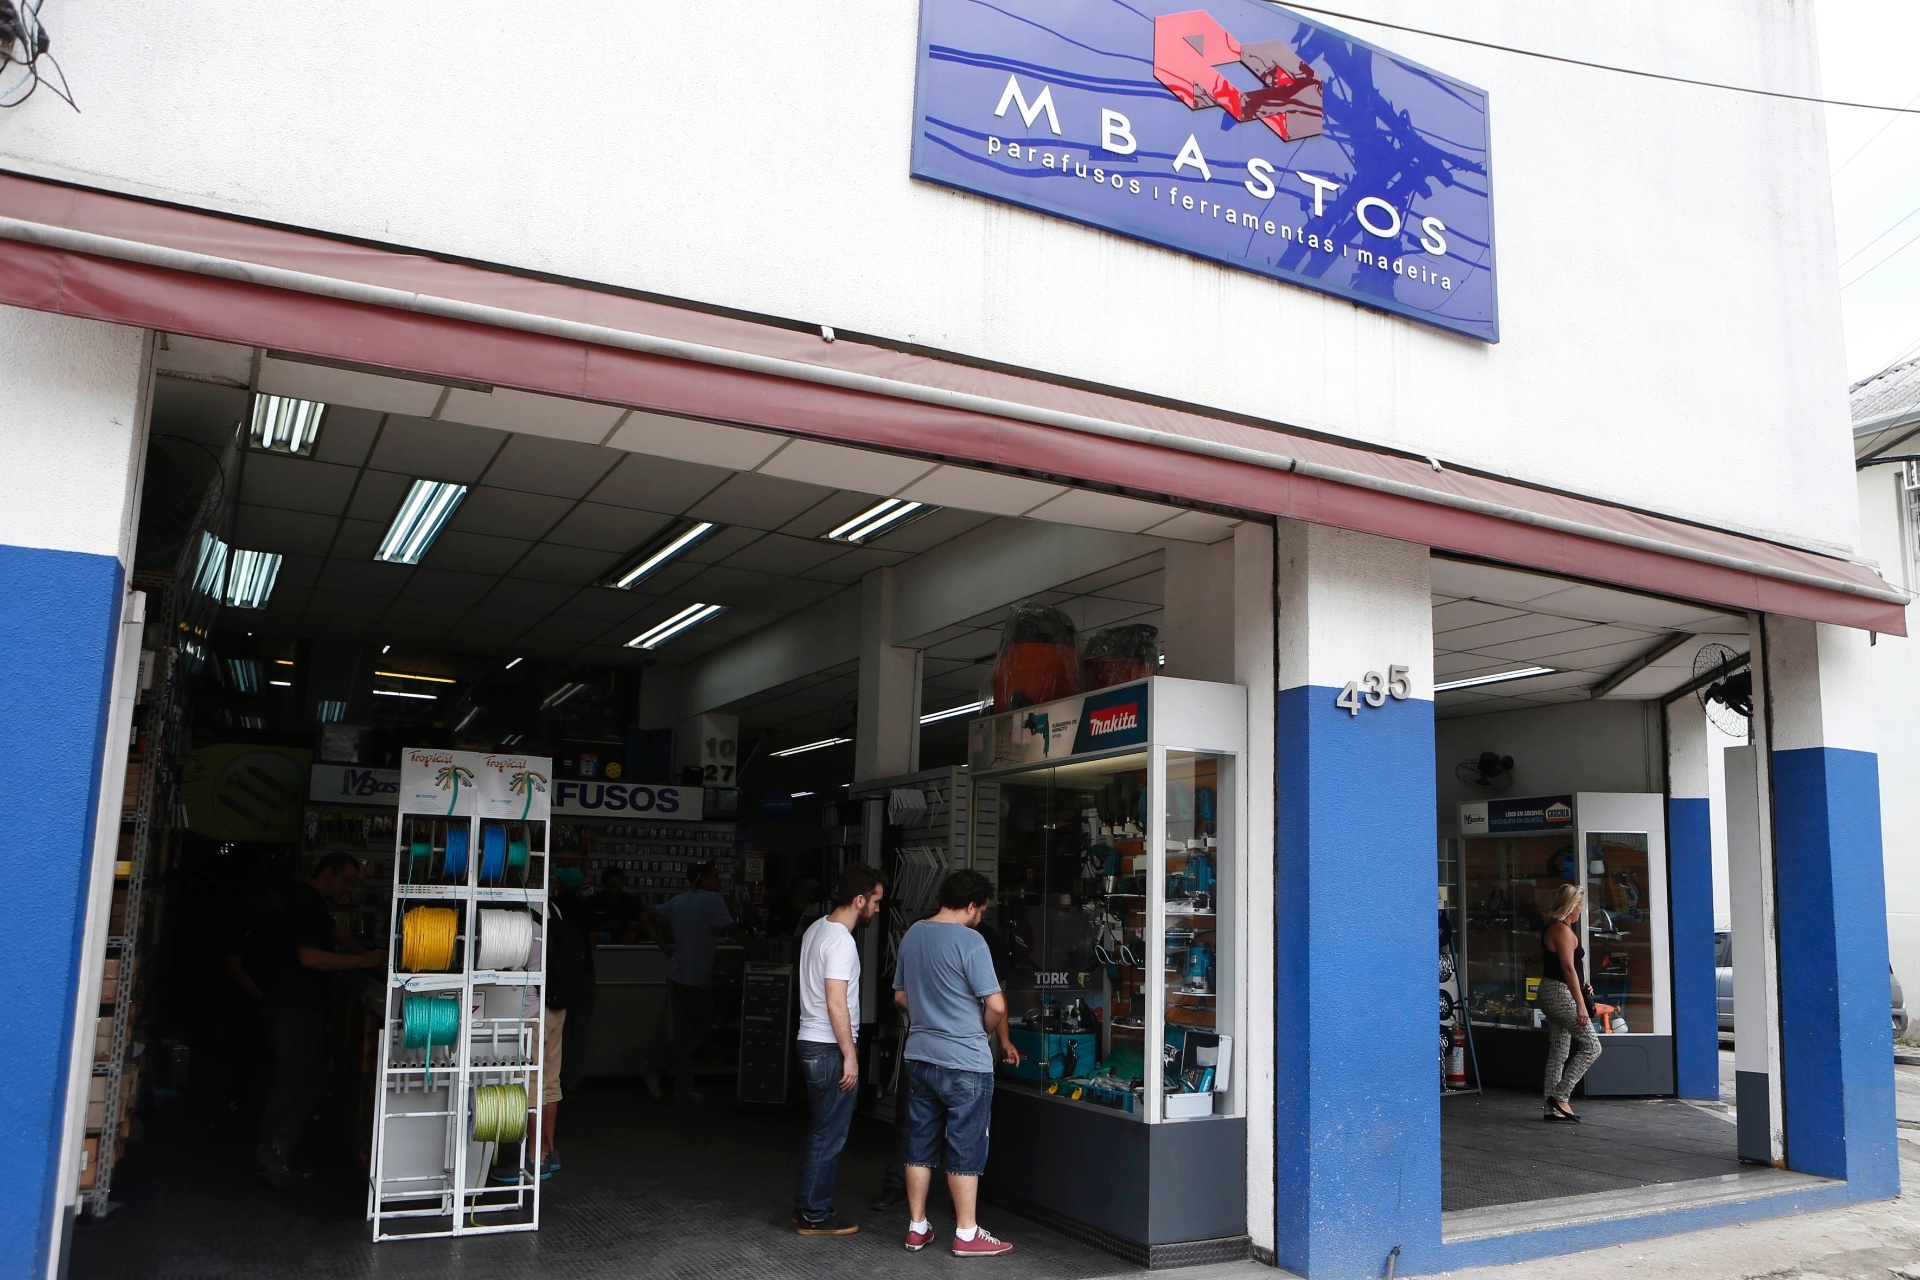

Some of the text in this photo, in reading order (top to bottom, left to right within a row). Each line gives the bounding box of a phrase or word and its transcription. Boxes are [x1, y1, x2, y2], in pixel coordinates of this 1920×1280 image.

[987, 134, 1452, 291] parafusos ferramentas madeira
[1335, 664, 1412, 716] 435
[408, 750, 453, 767] Tropical
[484, 755, 528, 773] Tropical
[704, 764, 735, 782] 27
[1034, 971, 1069, 985] TORK
